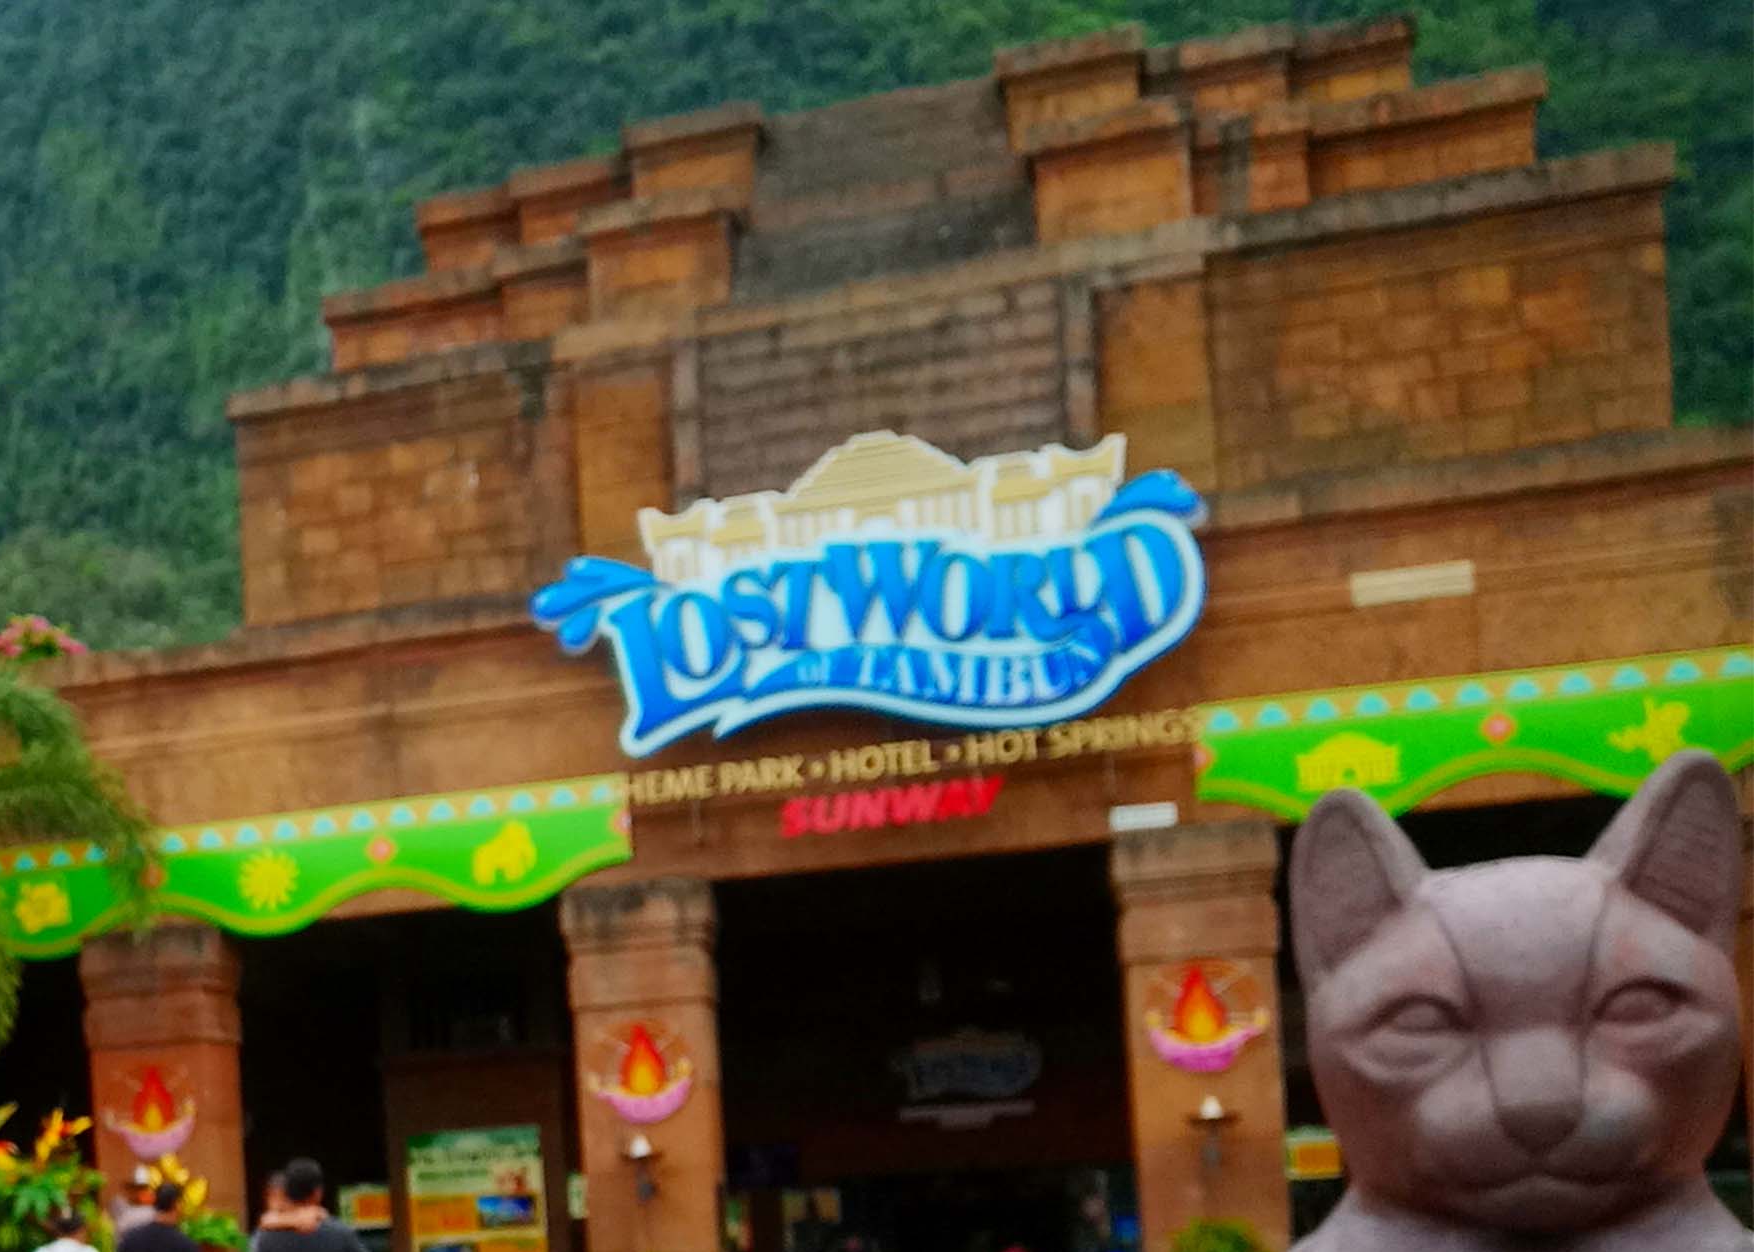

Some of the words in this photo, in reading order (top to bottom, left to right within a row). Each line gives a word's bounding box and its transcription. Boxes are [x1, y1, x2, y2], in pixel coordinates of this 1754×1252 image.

[626, 764, 714, 806] HEME
[717, 755, 803, 791] PARK
[831, 739, 939, 779] HOTEL
[966, 730, 1038, 765] HOT
[781, 776, 1003, 838] SUNWAY
